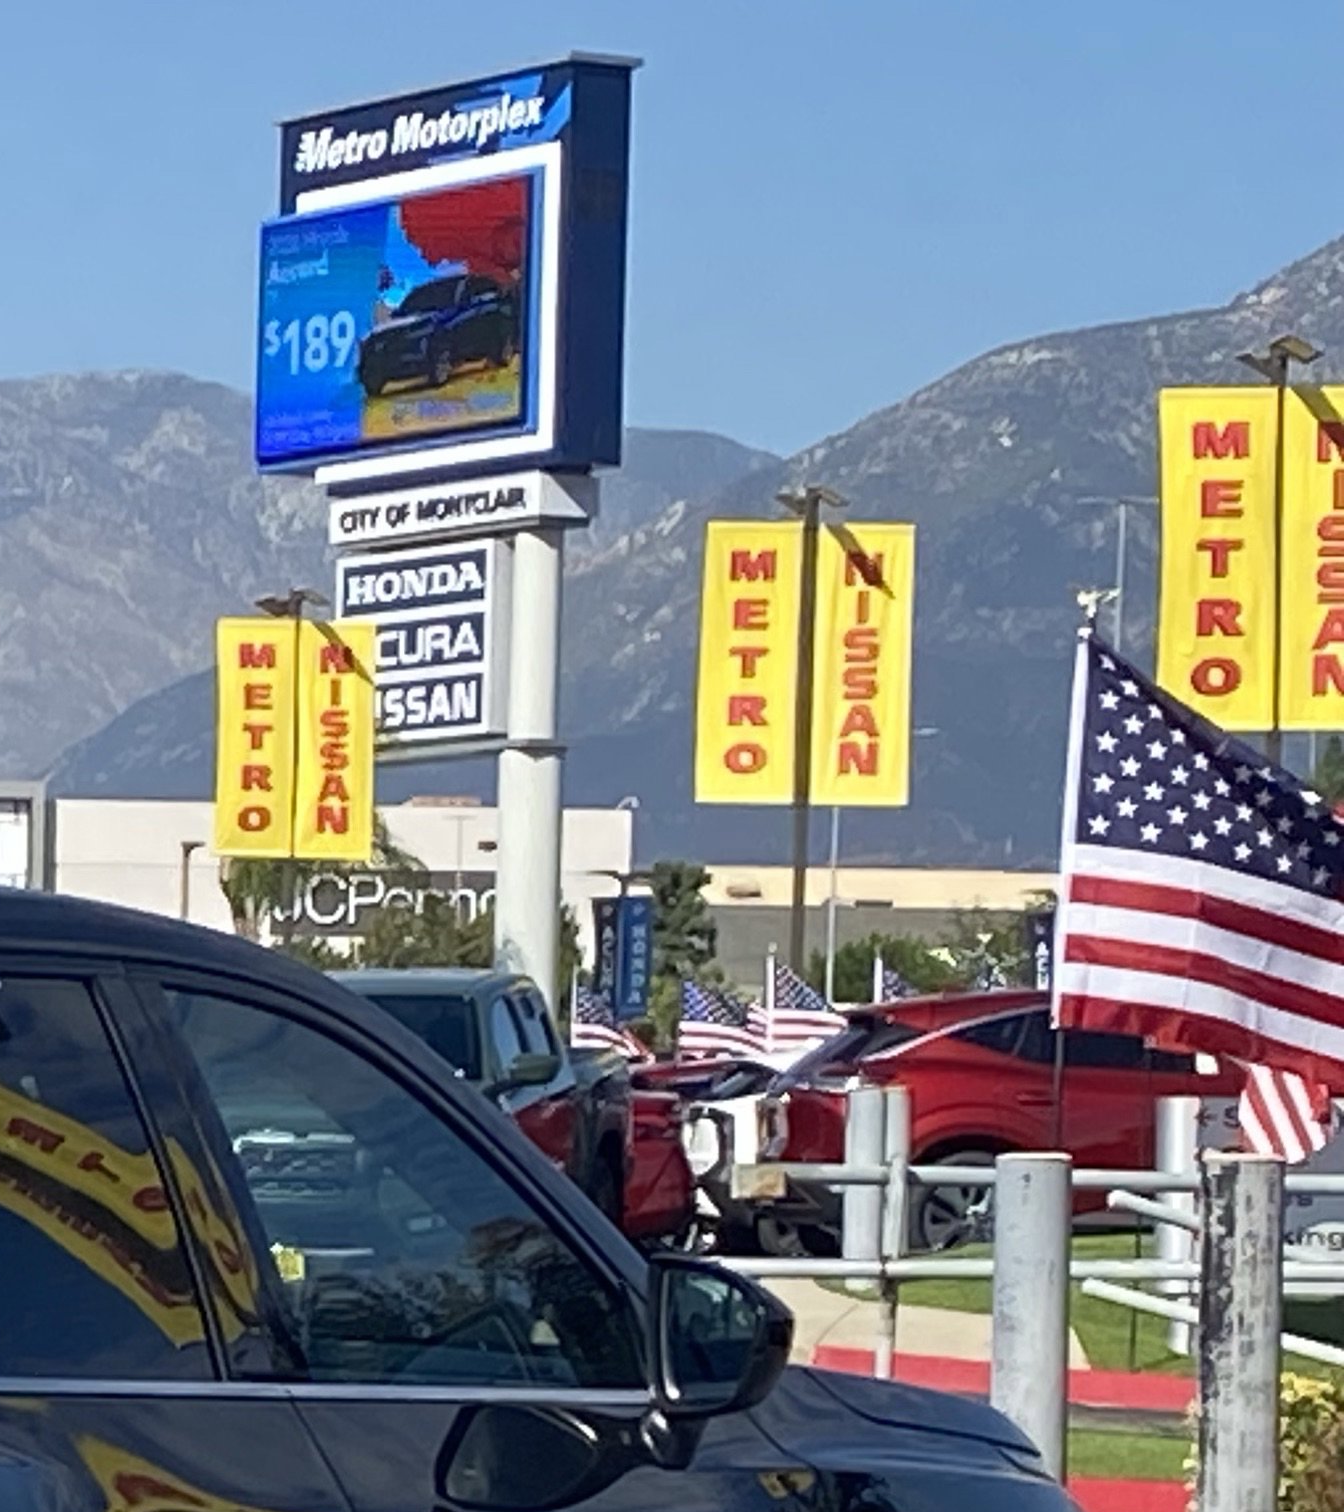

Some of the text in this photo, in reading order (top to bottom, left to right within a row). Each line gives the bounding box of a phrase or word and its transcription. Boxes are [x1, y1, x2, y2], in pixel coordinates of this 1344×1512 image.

[295, 92, 545, 173] Metro Motorplex
[264, 310, 356, 375] $189
[340, 487, 527, 534] CITY OF MONTCLAIR
[346, 561, 485, 606] HONDA
[1190, 421, 1250, 697] METRO
[375, 622, 480, 666] CURA
[723, 550, 778, 775] METRO
[837, 552, 884, 777] NISSAN
[237, 643, 277, 833] METRO
[316, 642, 355, 835] NISSAN
[375, 680, 478, 727] ISSAN
